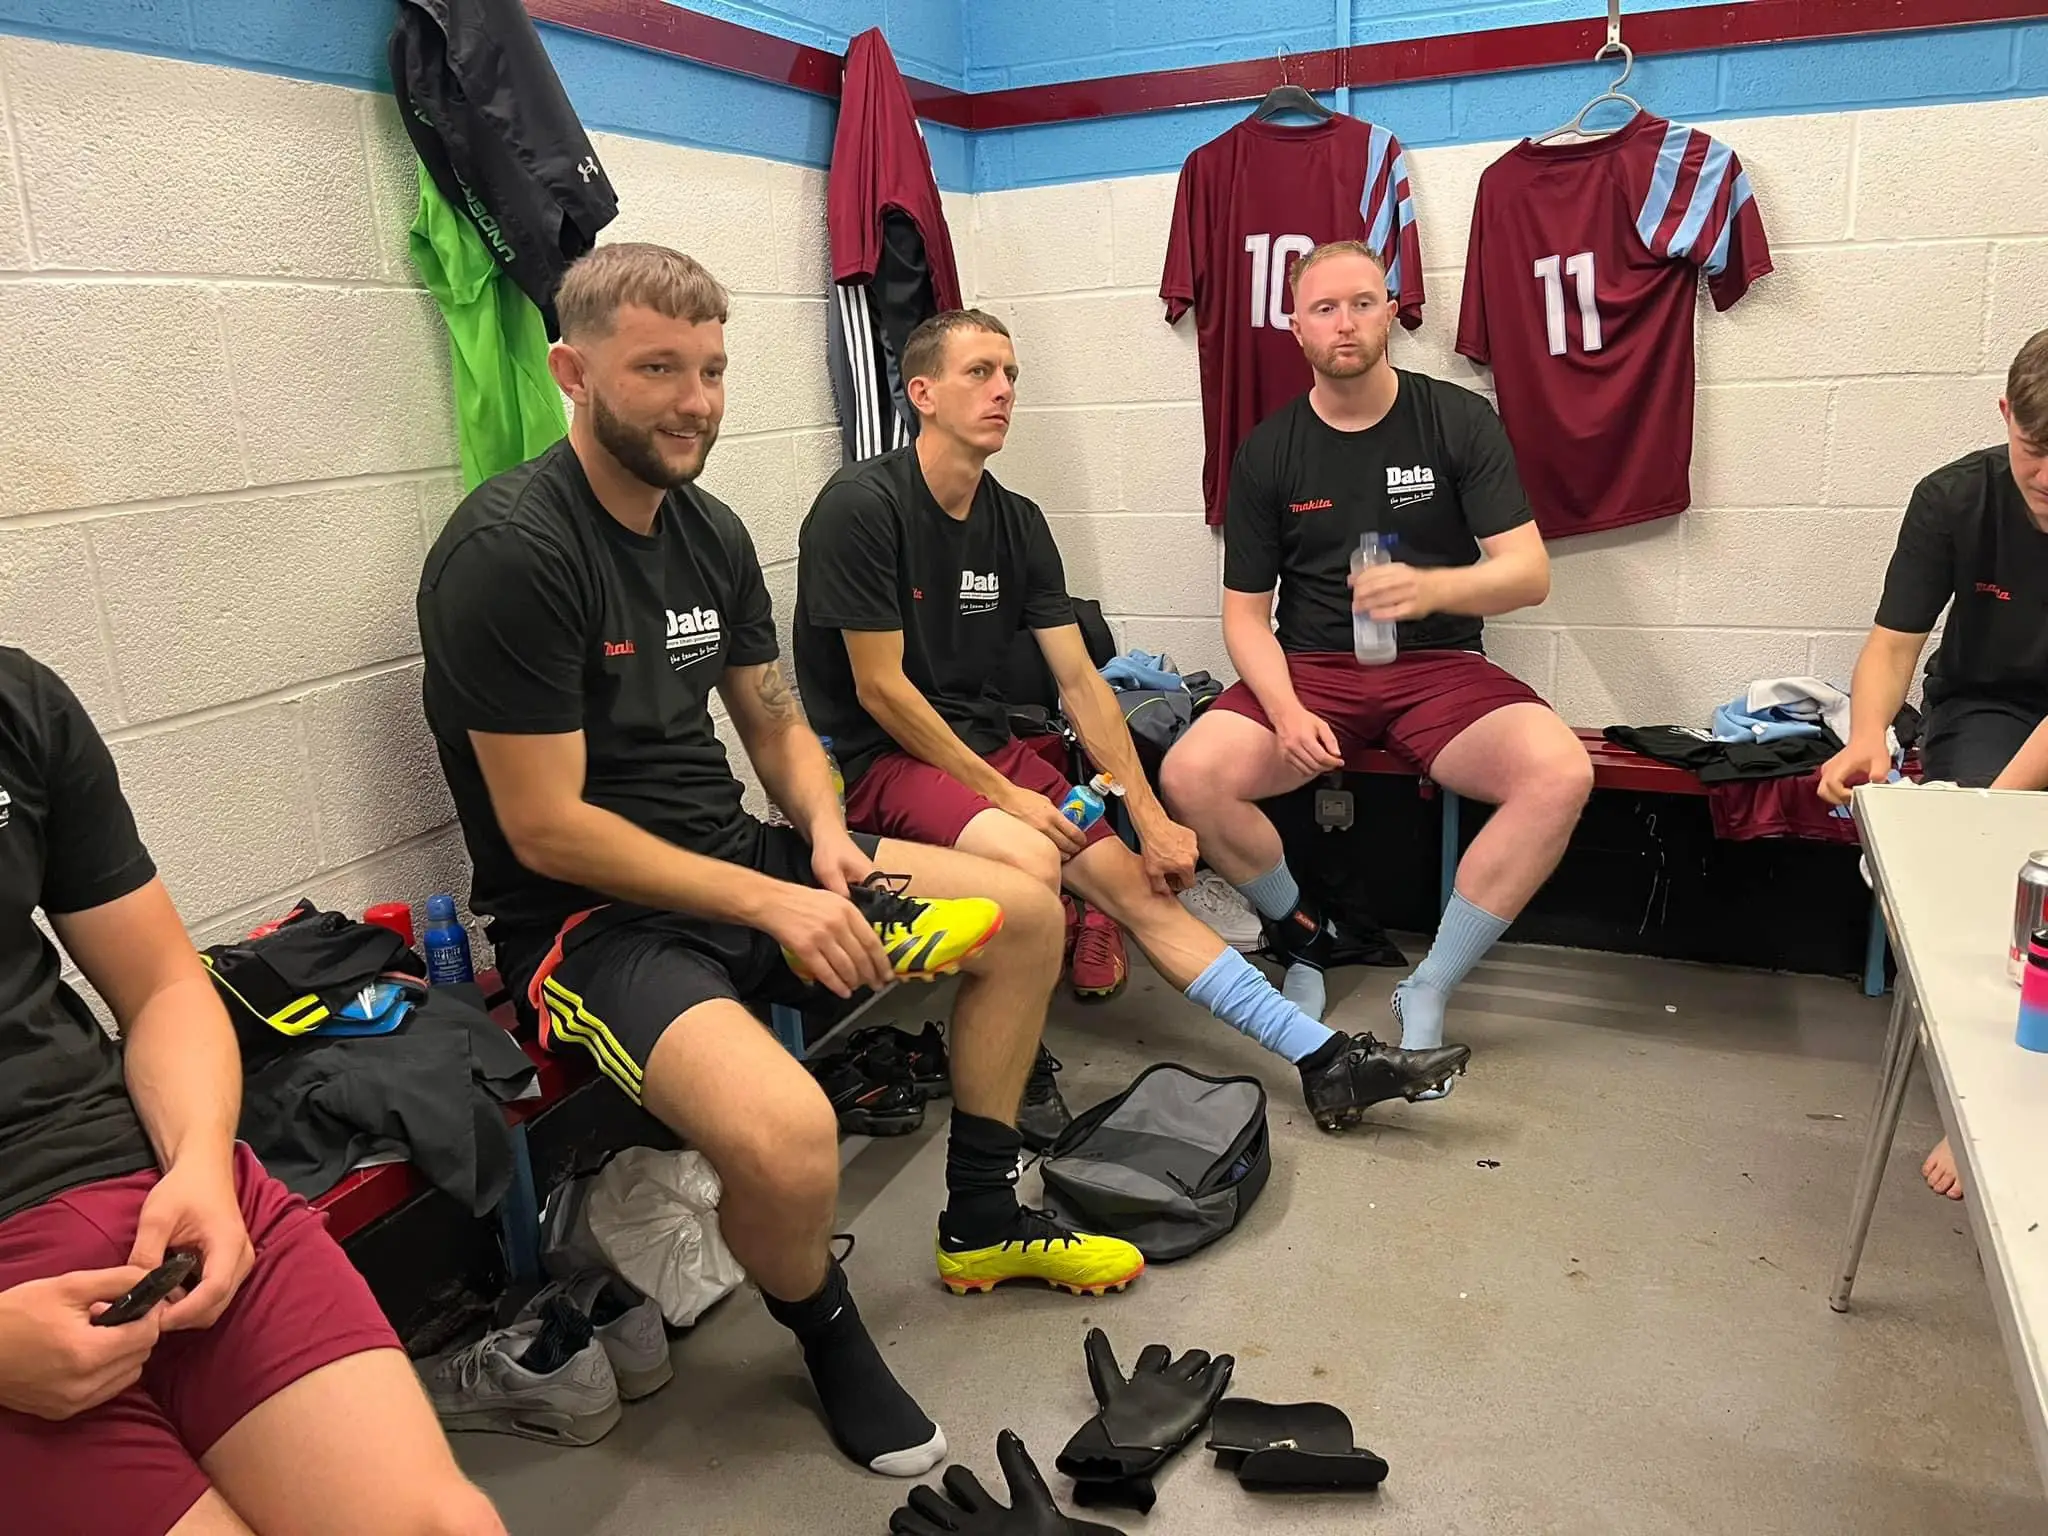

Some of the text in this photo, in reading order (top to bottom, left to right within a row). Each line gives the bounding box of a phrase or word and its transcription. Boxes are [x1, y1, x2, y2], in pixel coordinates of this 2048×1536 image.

[1534, 252, 1602, 355] 11
[1385, 464, 1435, 486] Data
[1288, 499, 1333, 512] makita
